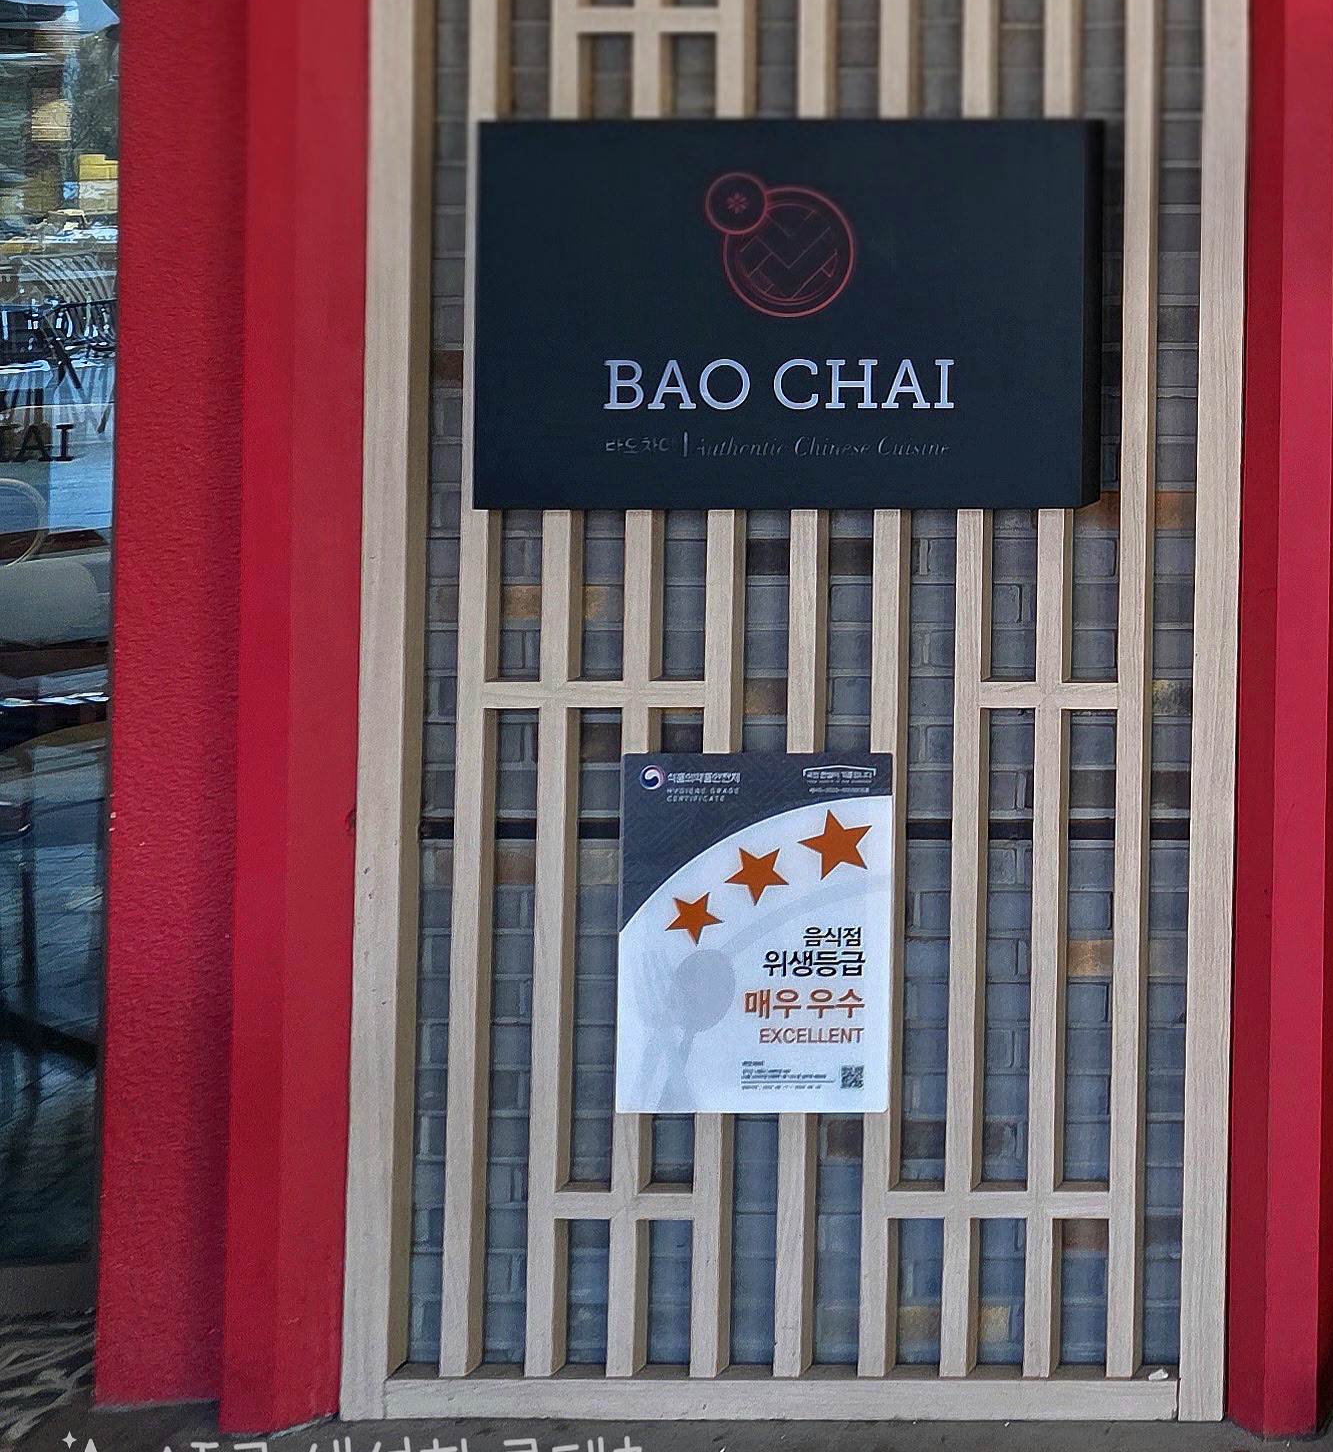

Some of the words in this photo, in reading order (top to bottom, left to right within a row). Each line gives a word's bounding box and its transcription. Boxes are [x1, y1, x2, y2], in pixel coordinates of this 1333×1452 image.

[603, 358, 751, 410] BAO
[773, 358, 955, 410] CHAI
[794, 435, 871, 457] Chinese
[877, 435, 951, 457] Cuisine
[802, 926, 862, 947] 음식점
[762, 950, 866, 977] 위생등급
[743, 989, 802, 1019] 매우
[806, 989, 866, 1019] 우수
[759, 1028, 865, 1044] EXCELLENT
